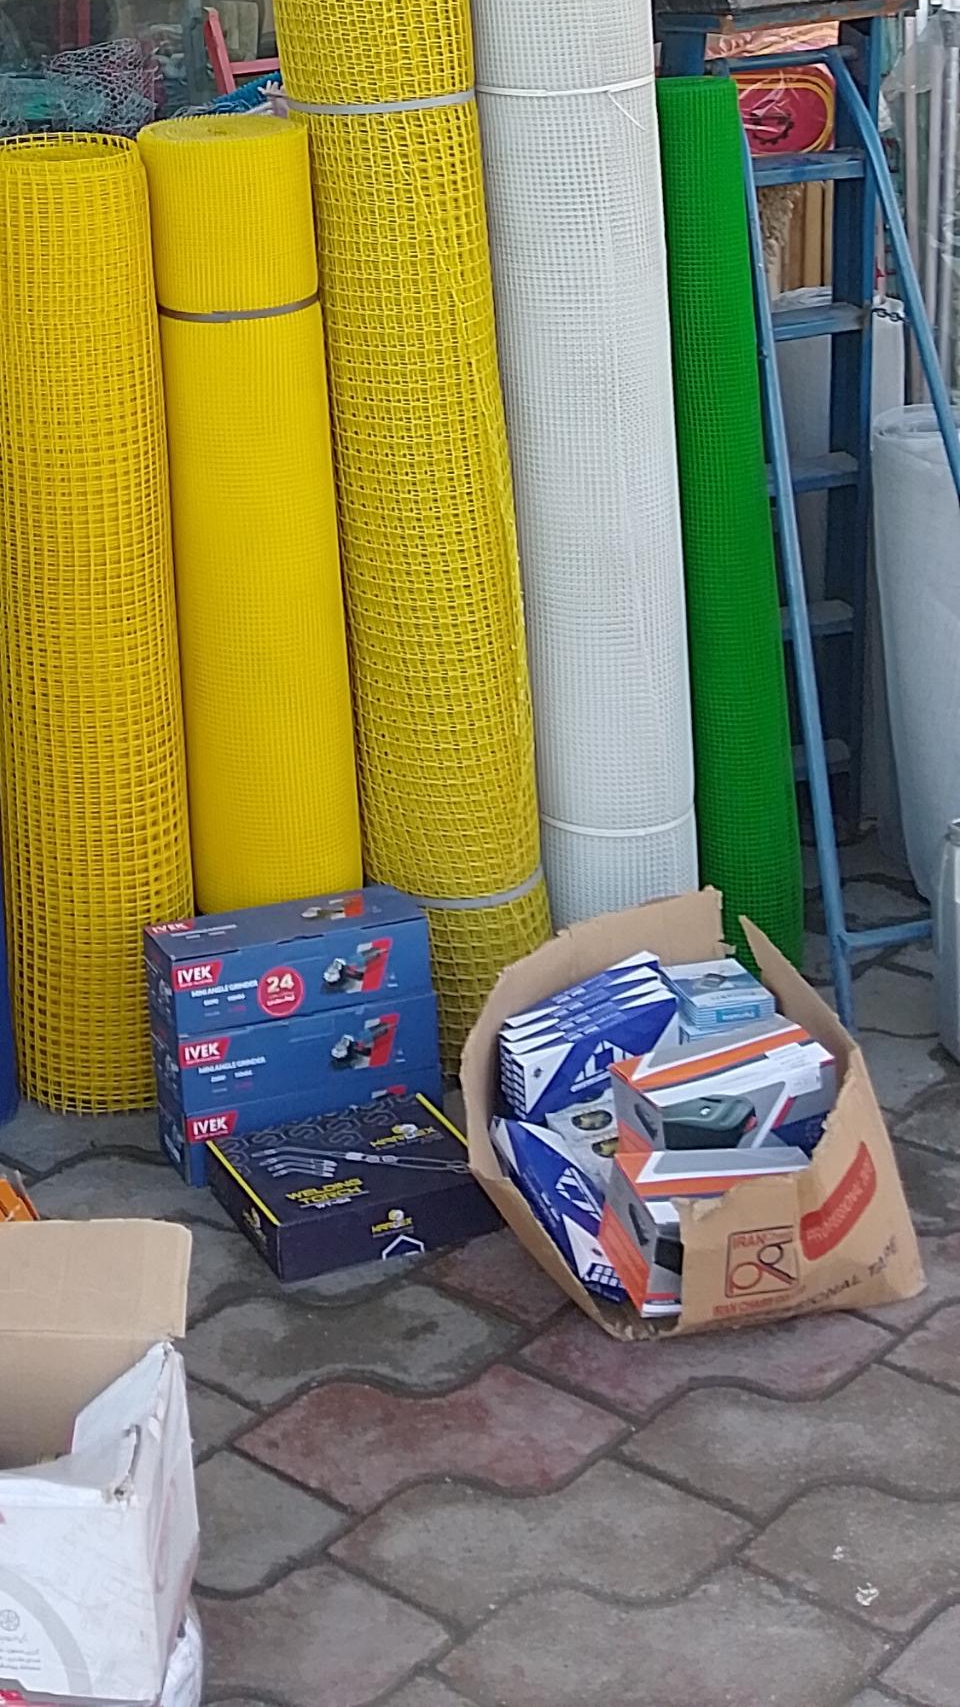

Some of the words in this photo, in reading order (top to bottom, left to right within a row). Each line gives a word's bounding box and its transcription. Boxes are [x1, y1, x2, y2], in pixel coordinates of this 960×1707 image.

[152, 921, 188, 934] IVEK
[177, 965, 213, 985] IVEK
[266, 973, 295, 994] 24
[184, 1042, 221, 1062] IVEK
[192, 1116, 228, 1137] IVEK
[285, 1177, 364, 1201] WELDING
[297, 1186, 362, 1204] TORCH
